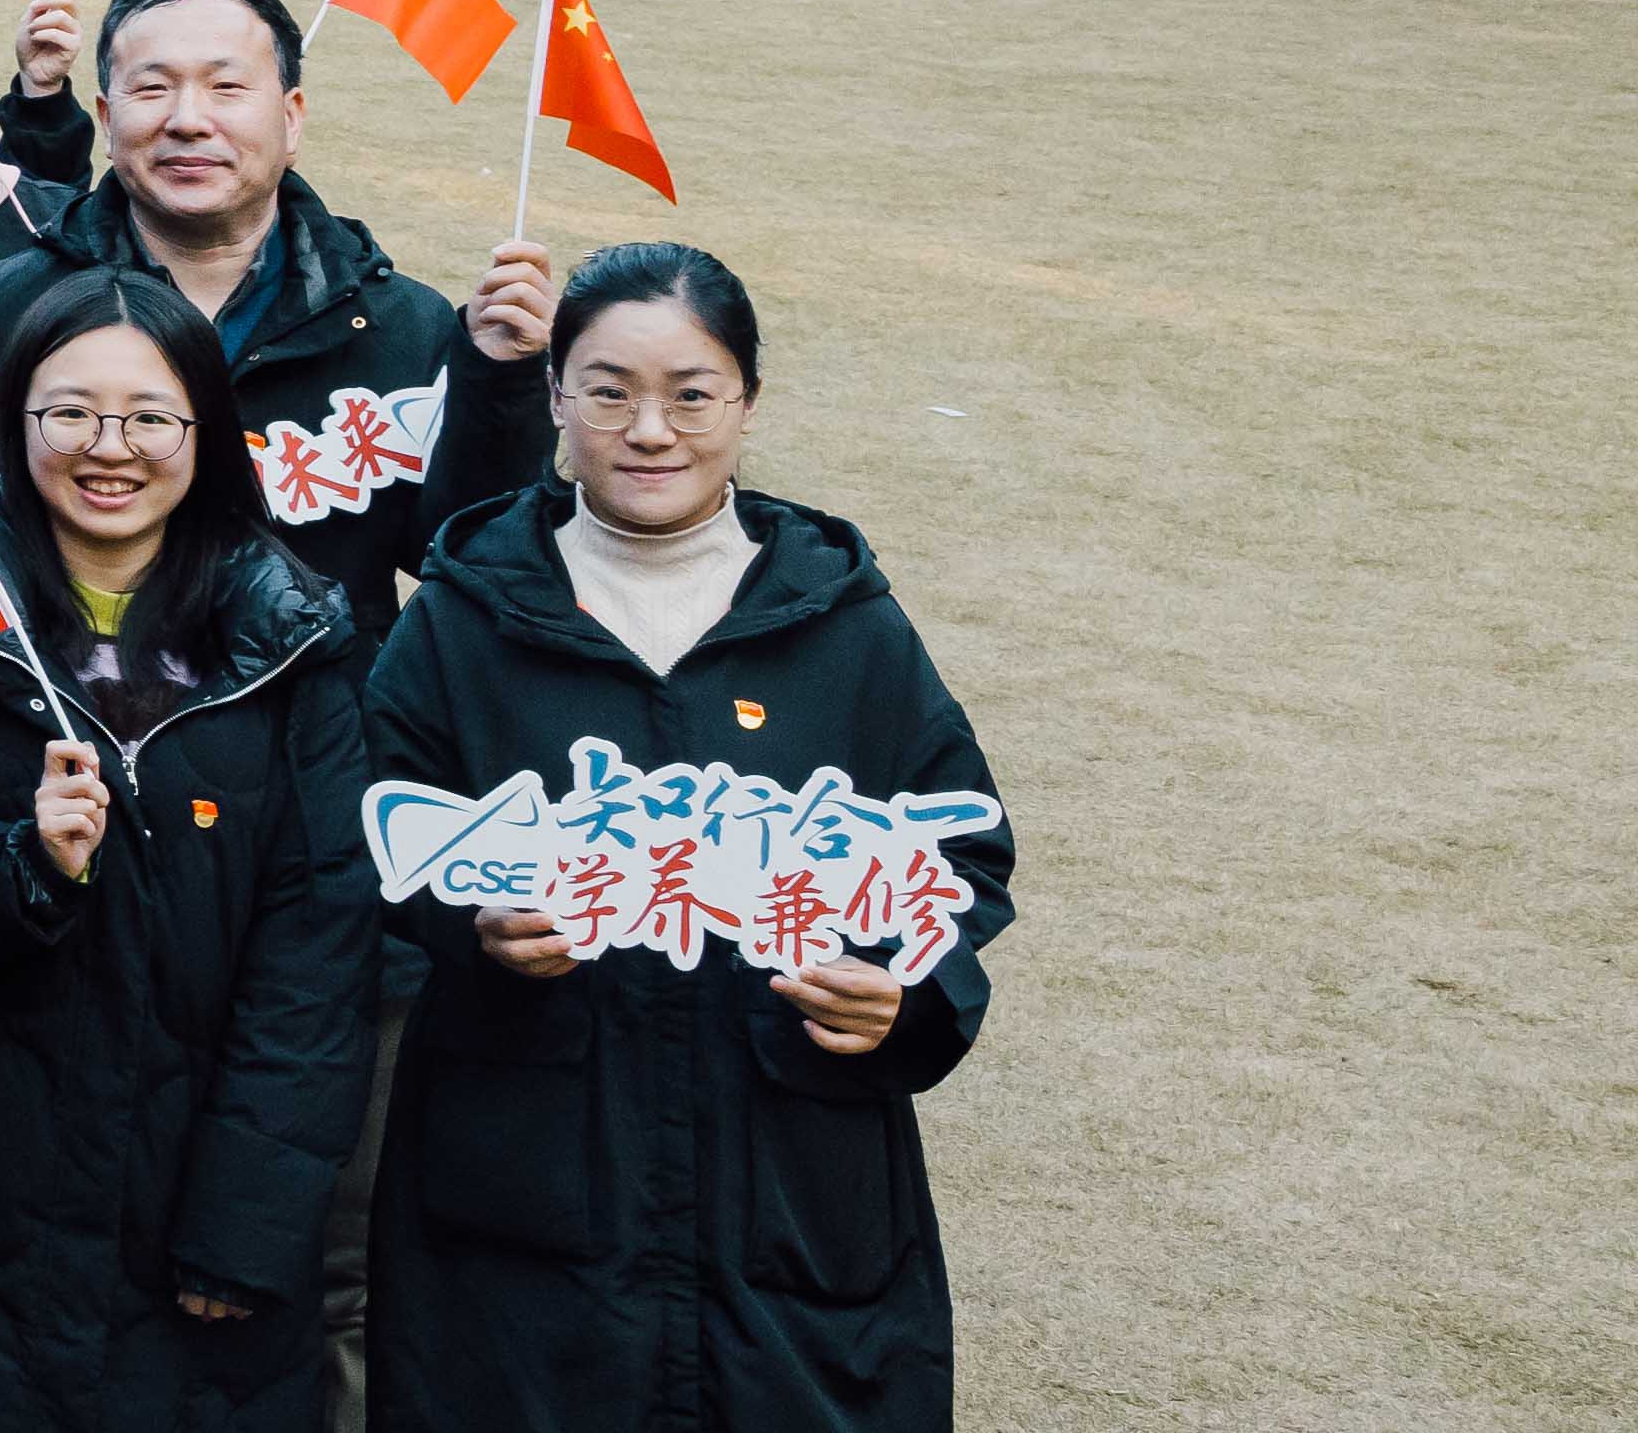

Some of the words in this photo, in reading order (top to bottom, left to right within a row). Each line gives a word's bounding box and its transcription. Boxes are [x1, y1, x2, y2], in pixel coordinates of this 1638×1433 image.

[254, 398, 423, 514] 未来
[556, 748, 988, 870] 知行合一
[444, 859, 538, 895] CSE
[545, 838, 960, 972] 学养兼修
